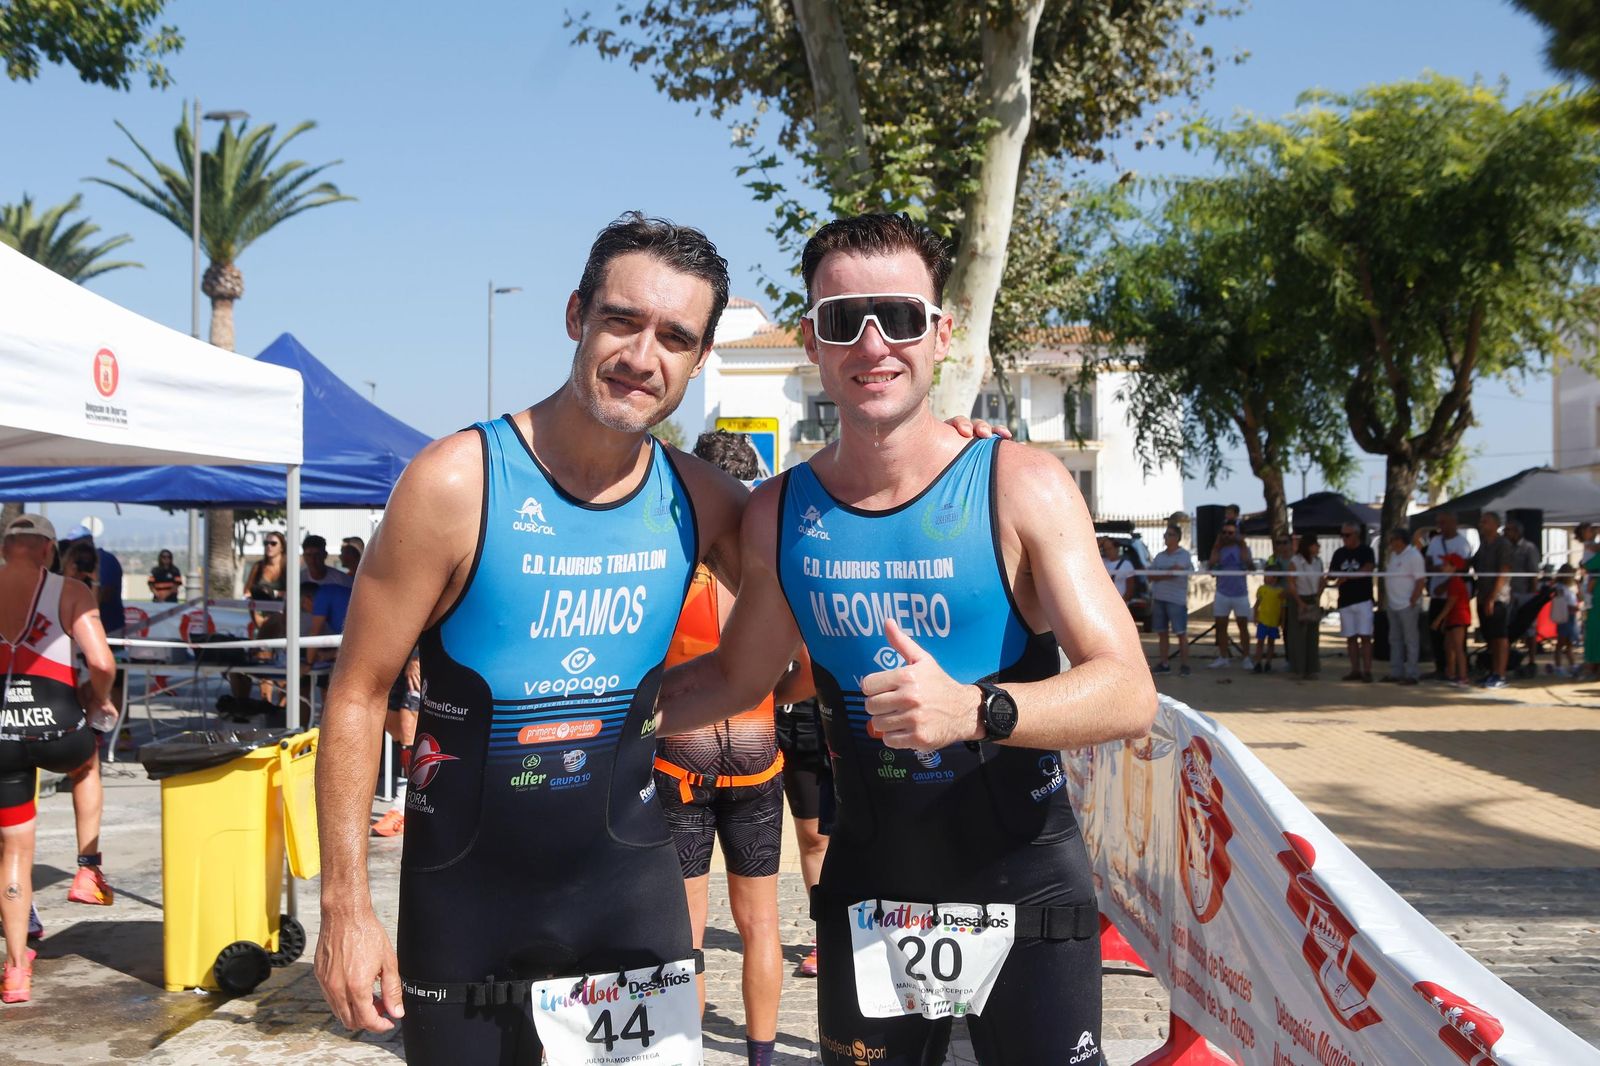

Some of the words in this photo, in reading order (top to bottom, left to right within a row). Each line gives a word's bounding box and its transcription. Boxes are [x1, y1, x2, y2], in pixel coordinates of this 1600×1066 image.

[513, 521, 556, 536] austral
[798, 525, 831, 541] austral
[522, 553, 546, 575] C.D.
[549, 556, 602, 576] LAURUS
[607, 549, 667, 574] TRIATLON
[803, 556, 822, 578] C.D.
[825, 560, 880, 579] LAURUS
[884, 557, 955, 579] TRIATLON
[529, 585, 647, 639] J.RAMOS
[524, 674, 620, 697] veopago
[510, 771, 547, 786] alfer
[550, 775, 580, 786] GRUPO
[581, 773, 591, 782] 10
[877, 765, 907, 778] alfer
[912, 771, 943, 780] GRUPO
[944, 770, 954, 778] 10
[943, 913, 1009, 928] Desaos
[897, 935, 963, 982] 20
[585, 1002, 655, 1053] 44
[606, 1055, 630, 1064] RAMOS
[631, 1052, 660, 1062] ORTEGA
